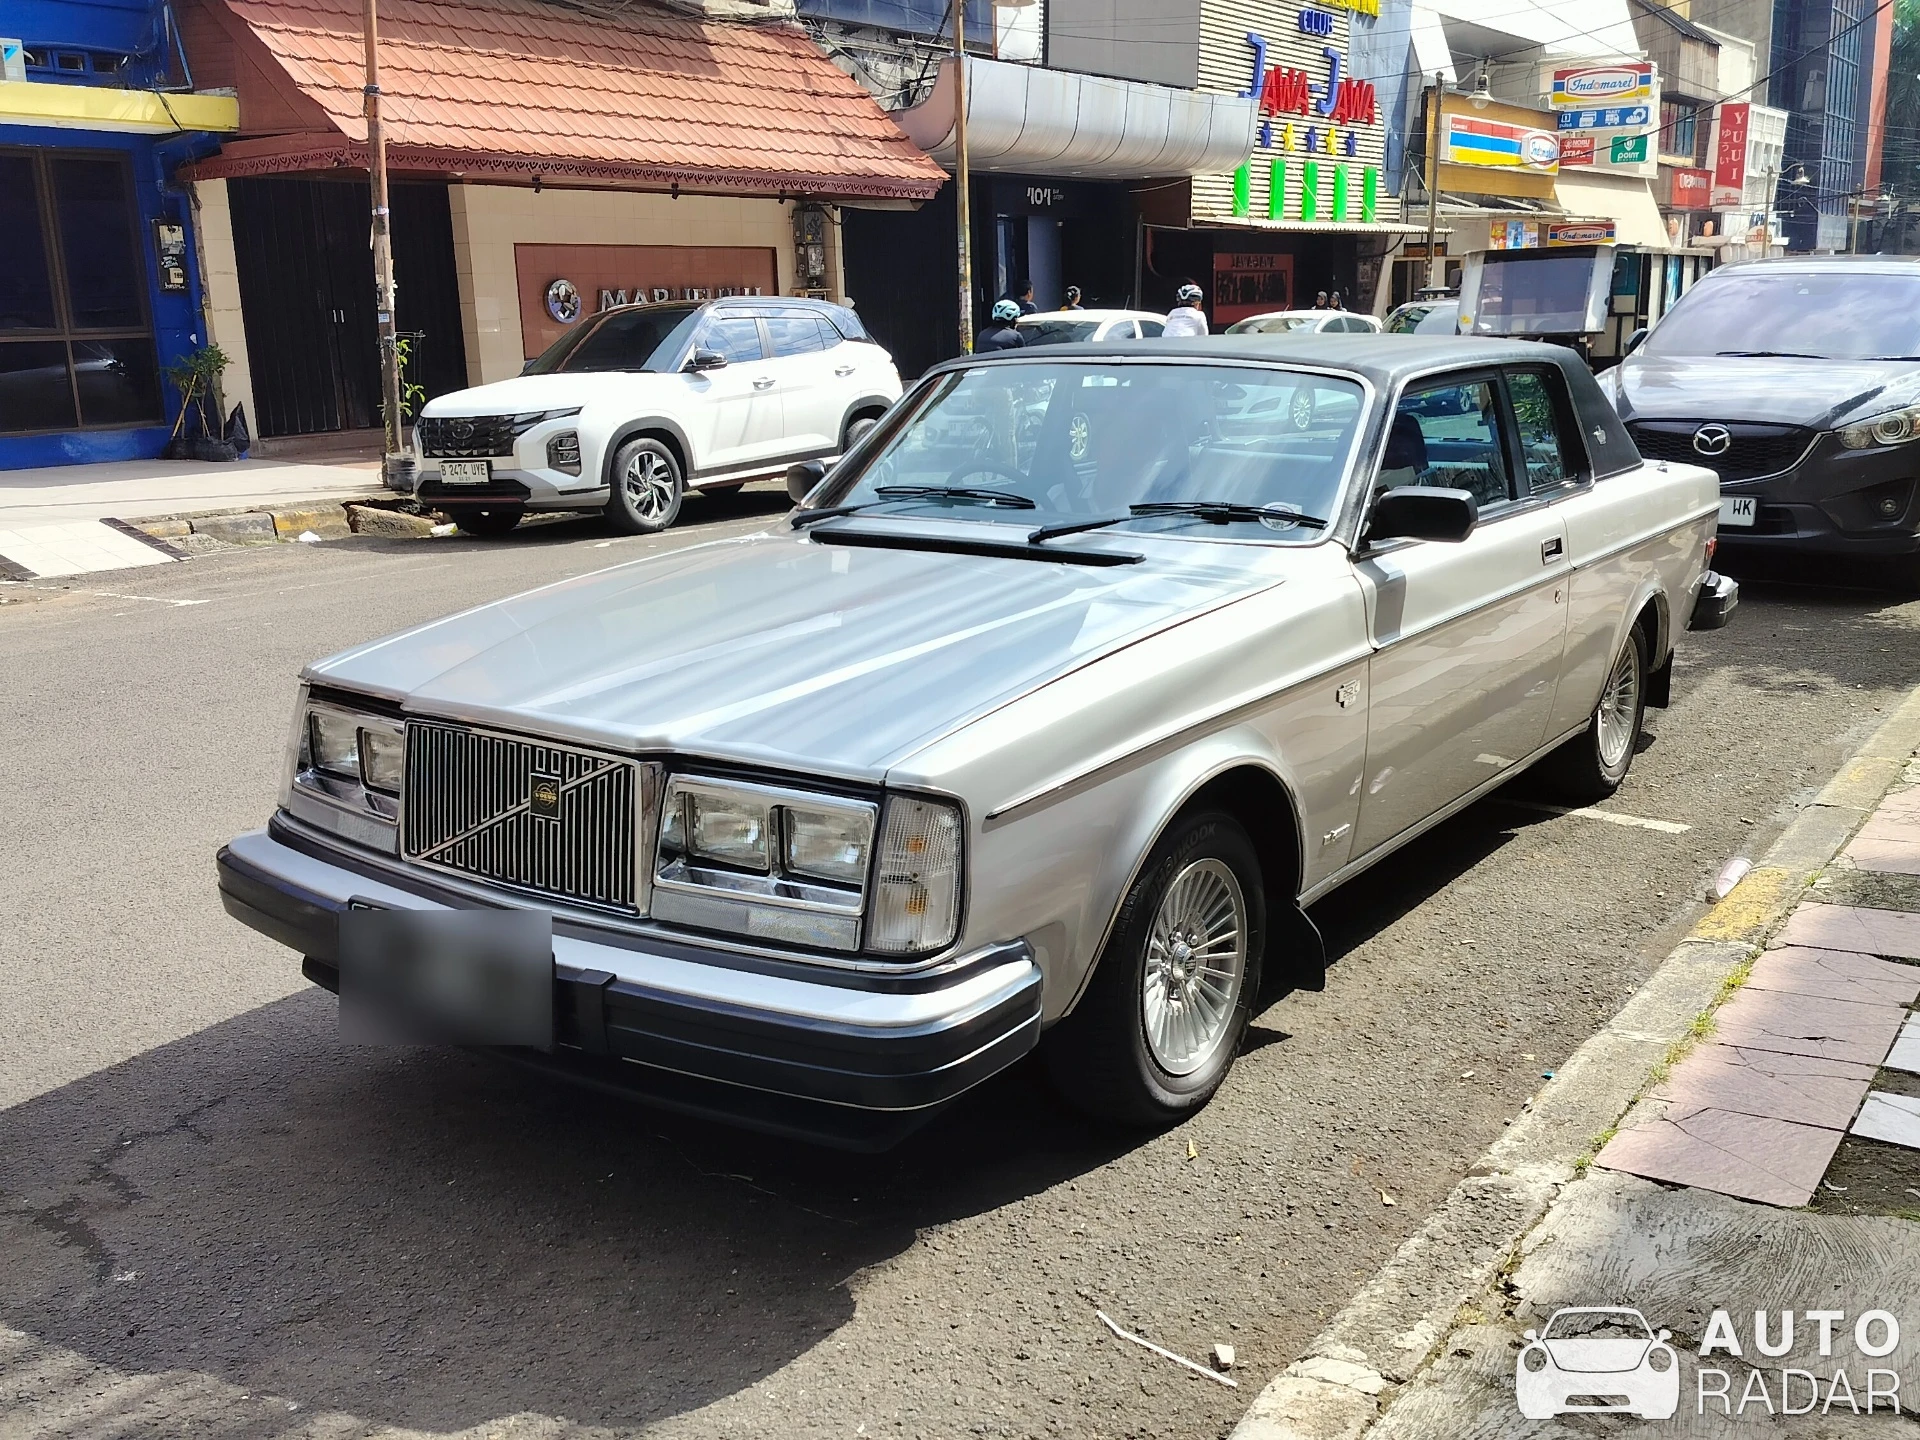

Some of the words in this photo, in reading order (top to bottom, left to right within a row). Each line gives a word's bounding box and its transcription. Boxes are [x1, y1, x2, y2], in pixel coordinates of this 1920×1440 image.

[1299, 9, 1333, 36] CLUB
[1570, 76, 1633, 91] Indomaret
[1731, 111, 1745, 180] YUUI
[1560, 231, 1603, 240] Indomaret
[441, 464, 447, 476] B
[449, 463, 468, 476] 2474
[471, 463, 486, 476] UYE
[1732, 499, 1752, 516] WK
[535, 792, 557, 801] VOLVO
